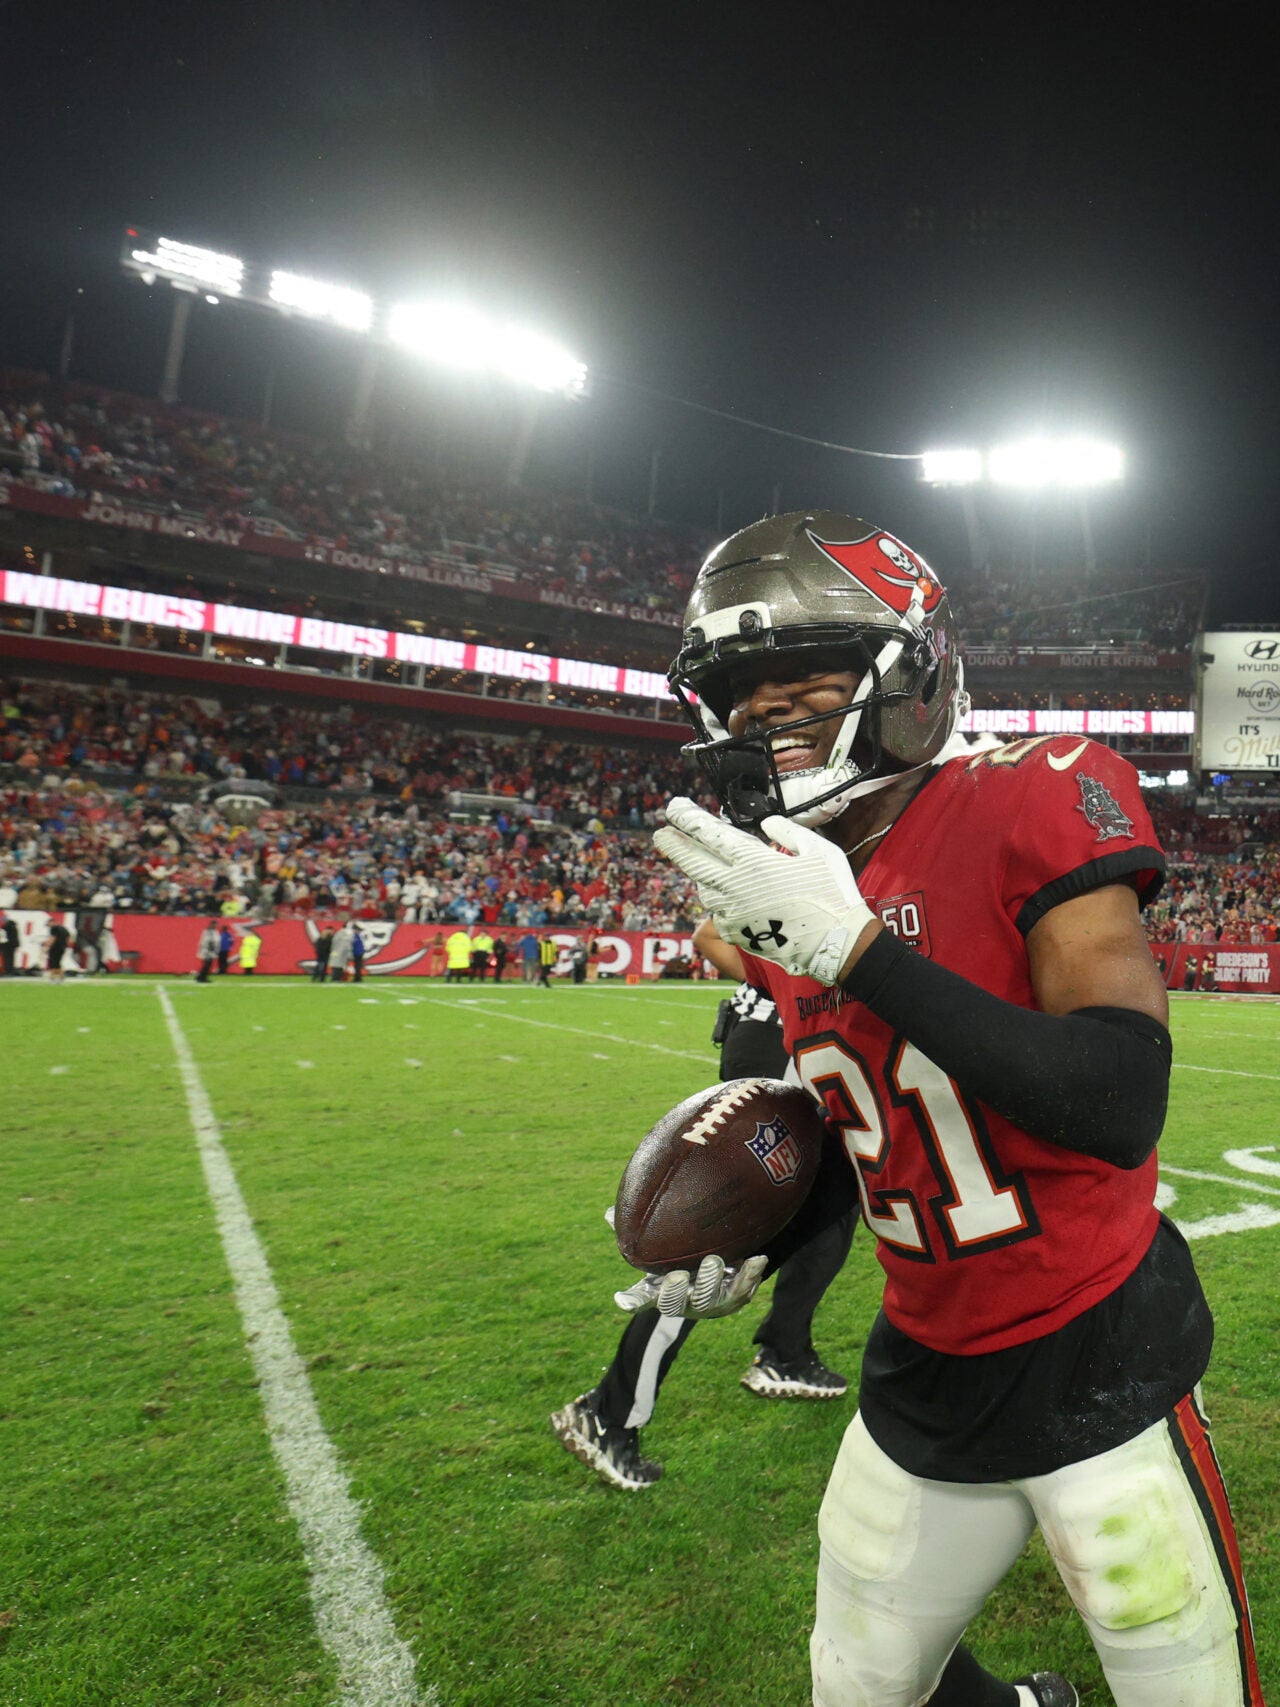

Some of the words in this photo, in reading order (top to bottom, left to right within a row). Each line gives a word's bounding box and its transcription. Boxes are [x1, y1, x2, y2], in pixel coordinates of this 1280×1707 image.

[83, 505, 153, 531] JOHN
[625, 670, 688, 701] BUC
[1237, 687, 1264, 698] Hard
[1239, 725, 1260, 735] IT'S
[881, 902, 921, 937] 50
[766, 1138, 801, 1180] NFL
[793, 1029, 1042, 1264] 21
